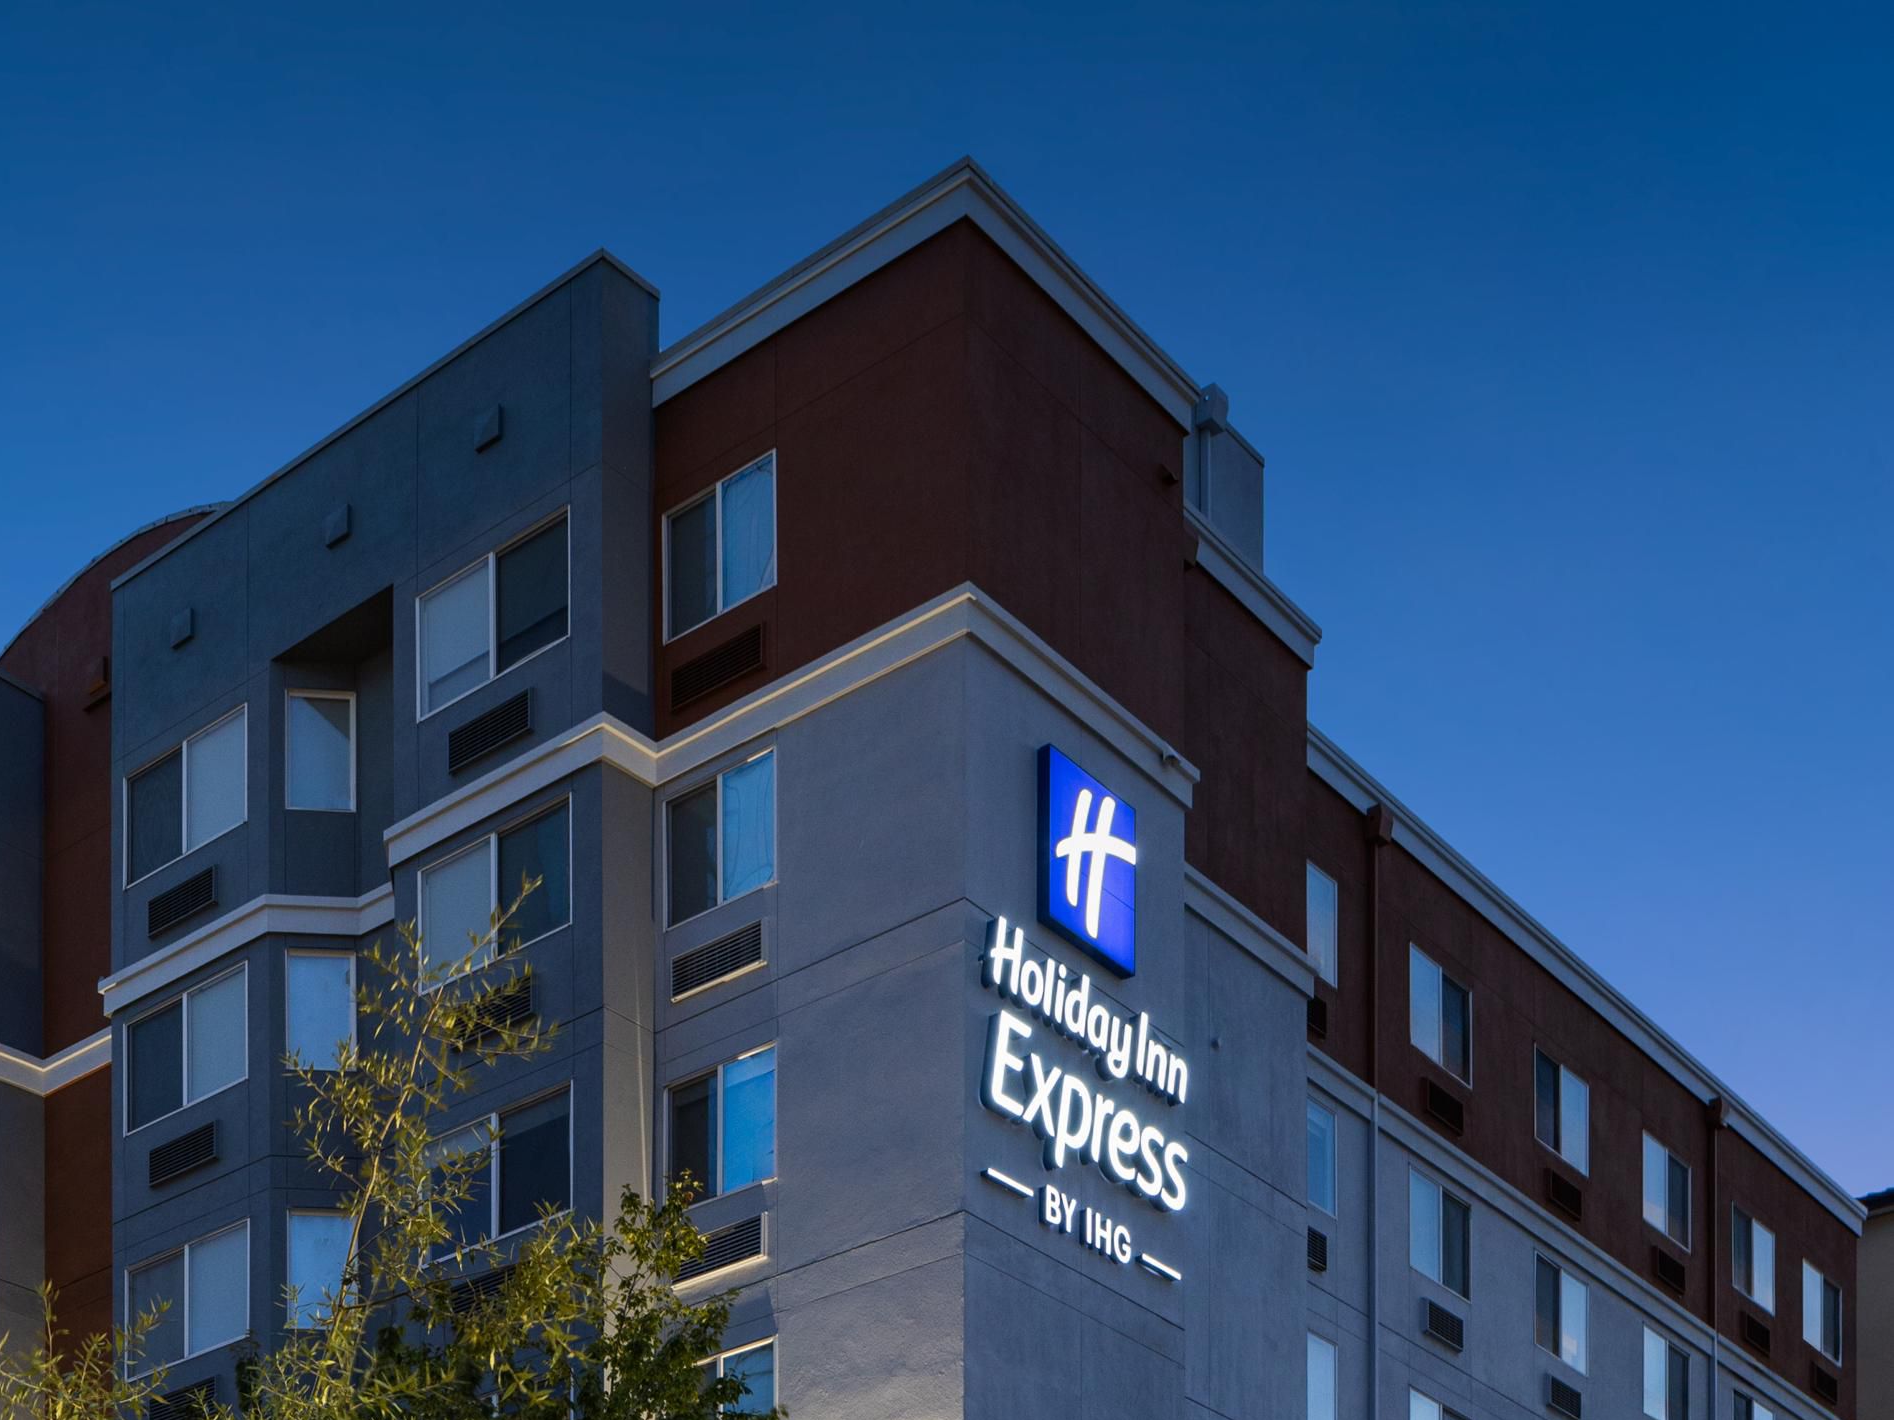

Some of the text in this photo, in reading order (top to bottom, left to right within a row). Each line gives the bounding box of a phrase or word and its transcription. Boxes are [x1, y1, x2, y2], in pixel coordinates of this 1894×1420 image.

[989, 915, 1189, 1105] Holiday Inn
[989, 1008, 1189, 1212] Express
[1044, 1184, 1132, 1265] BY IHG
